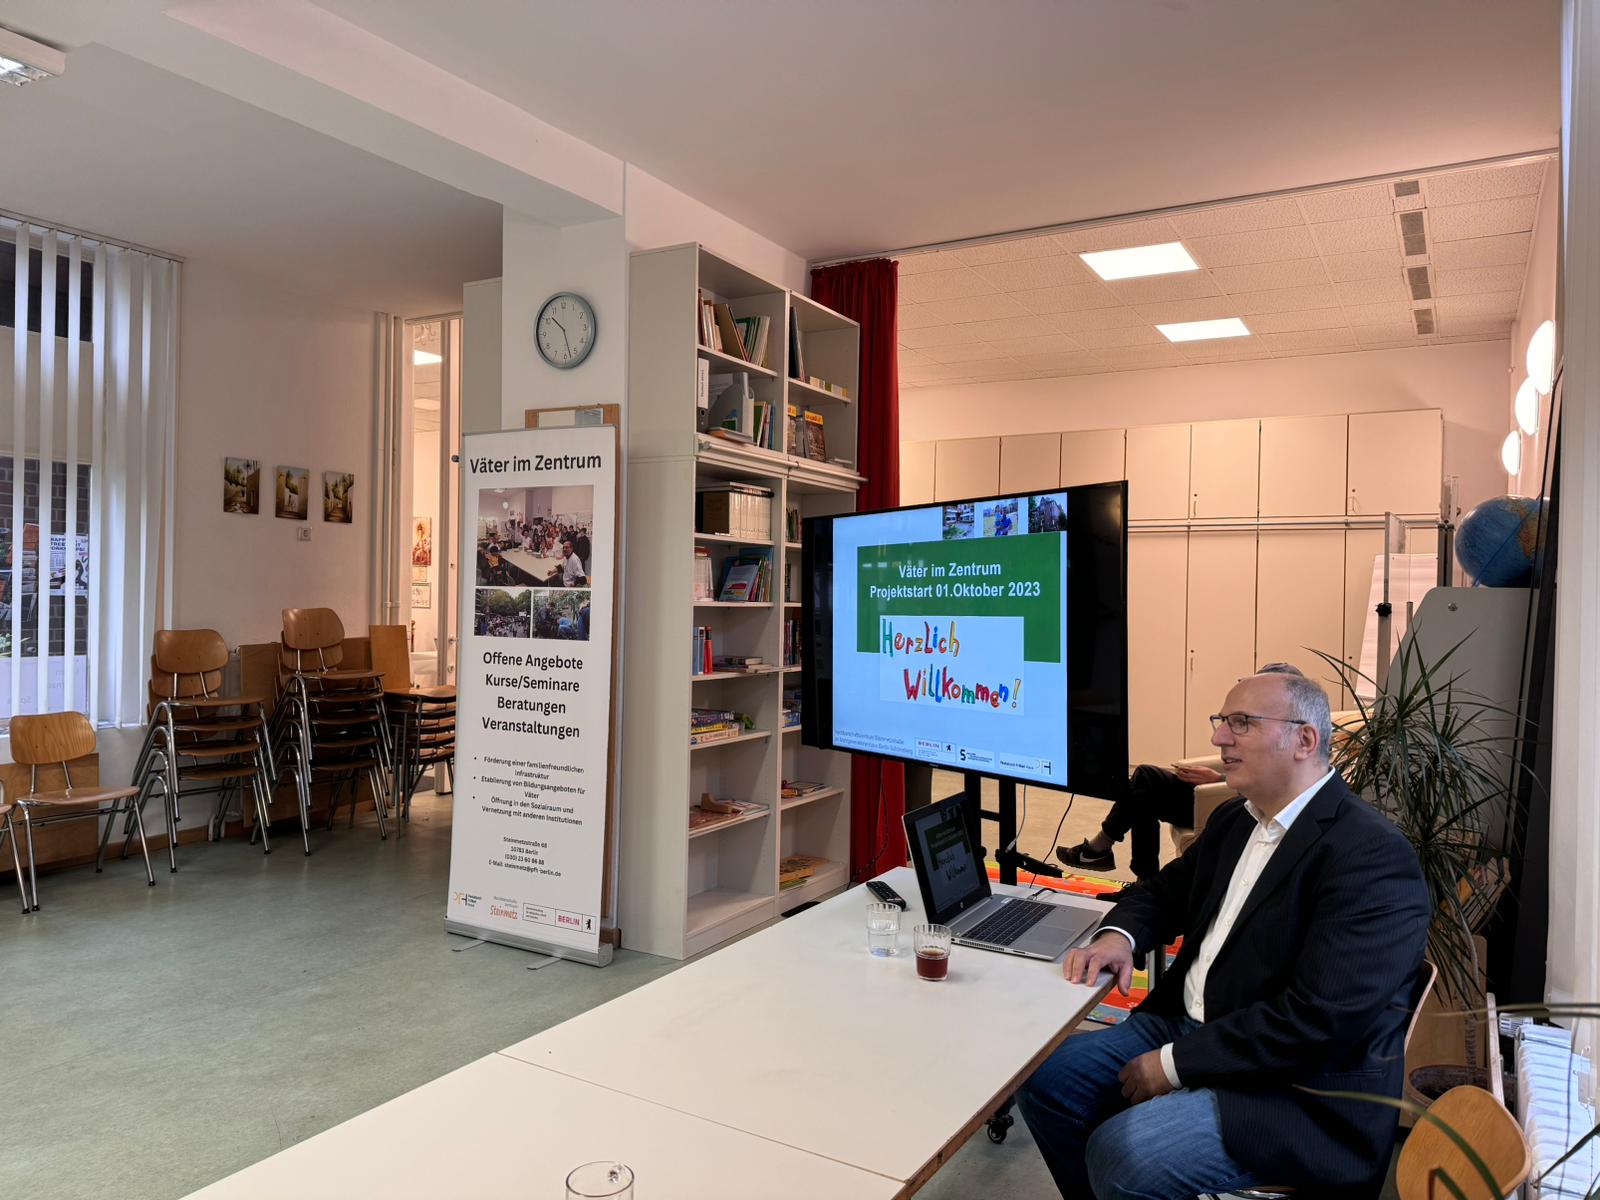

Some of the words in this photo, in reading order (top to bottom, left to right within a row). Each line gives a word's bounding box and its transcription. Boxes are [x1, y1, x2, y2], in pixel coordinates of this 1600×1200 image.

[470, 457, 510, 474] Väter
[513, 456, 531, 472] im
[534, 454, 602, 472] Zentrum
[898, 564, 928, 578] Väter
[931, 563, 946, 577] im
[948, 562, 1001, 577] Zentrum
[870, 584, 932, 600] Projektstart
[936, 582, 1004, 598] 01.Oktober
[1008, 581, 1041, 598] 2023
[483, 652, 522, 666] Offene
[525, 654, 583, 670] Angebote
[485, 674, 580, 692] Kurse/Seminare
[904, 664, 1022, 709] Willkommen!
[497, 696, 566, 716] Beratungen
[482, 717, 580, 740] Veranstaltungen
[484, 756, 511, 767] Förderung
[526, 761, 584, 773] familienfreundlichen
[514, 770, 550, 780] Infrastruktur
[481, 776, 512, 787] Etablierung
[523, 781, 577, 794] Bildungsangeboten
[491, 796, 512, 807] Öffnung
[531, 802, 561, 812] Sozialraum
[524, 791, 539, 799] Väter
[482, 806, 512, 817] Vernetzung
[523, 812, 545, 820] anderen
[546, 814, 582, 825] Institutionen
[558, 915, 580, 926] BERLIN
